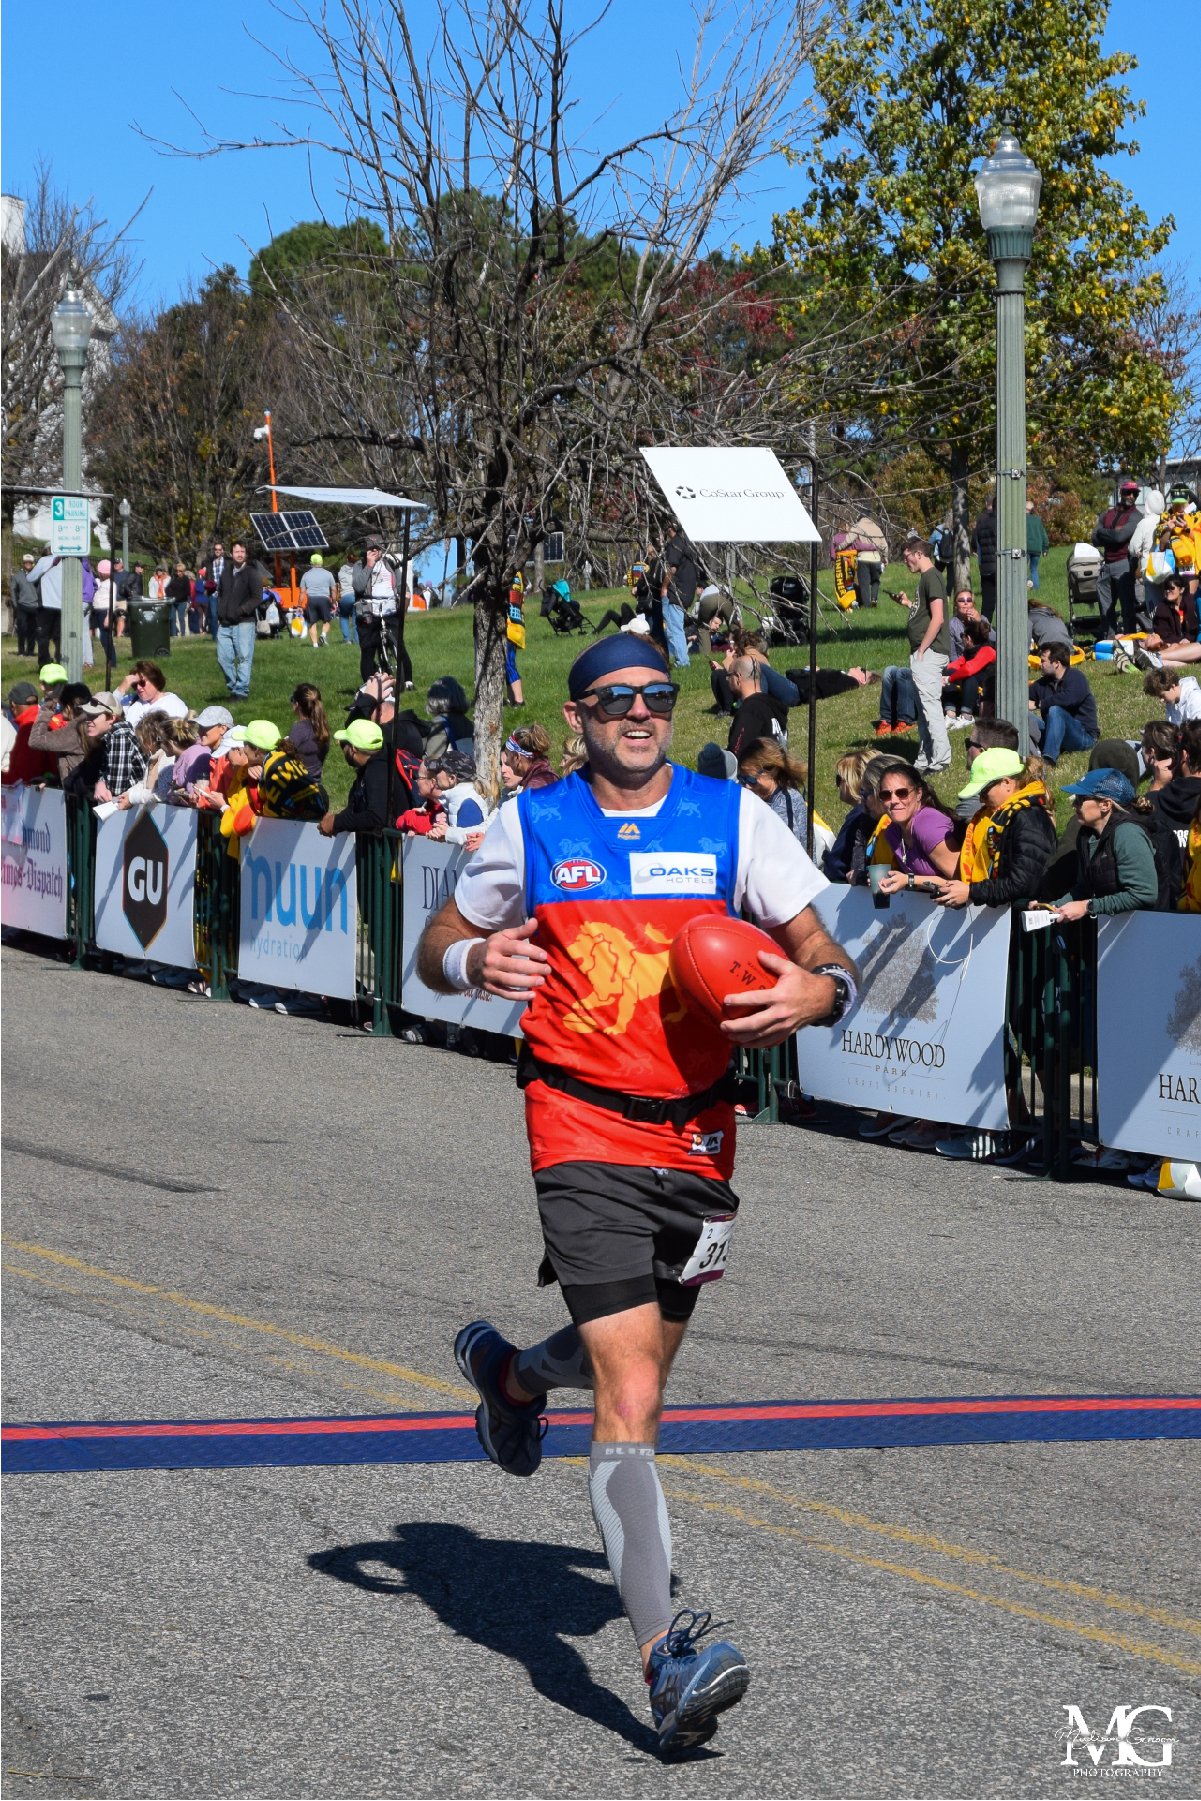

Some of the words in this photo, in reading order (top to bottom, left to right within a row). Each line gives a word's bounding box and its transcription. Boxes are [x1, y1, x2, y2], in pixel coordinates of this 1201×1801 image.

[54, 500, 63, 516] 3
[128, 855, 163, 905] GU
[556, 866, 601, 884] AFL
[650, 867, 714, 877] OAKS
[667, 877, 714, 885] HOTELS
[244, 846, 348, 935] nuun
[249, 930, 309, 961] hydration
[842, 1029, 946, 1068] HARDYWOOD
[875, 1064, 907, 1077] PARK
[707, 1228, 713, 1239] 2
